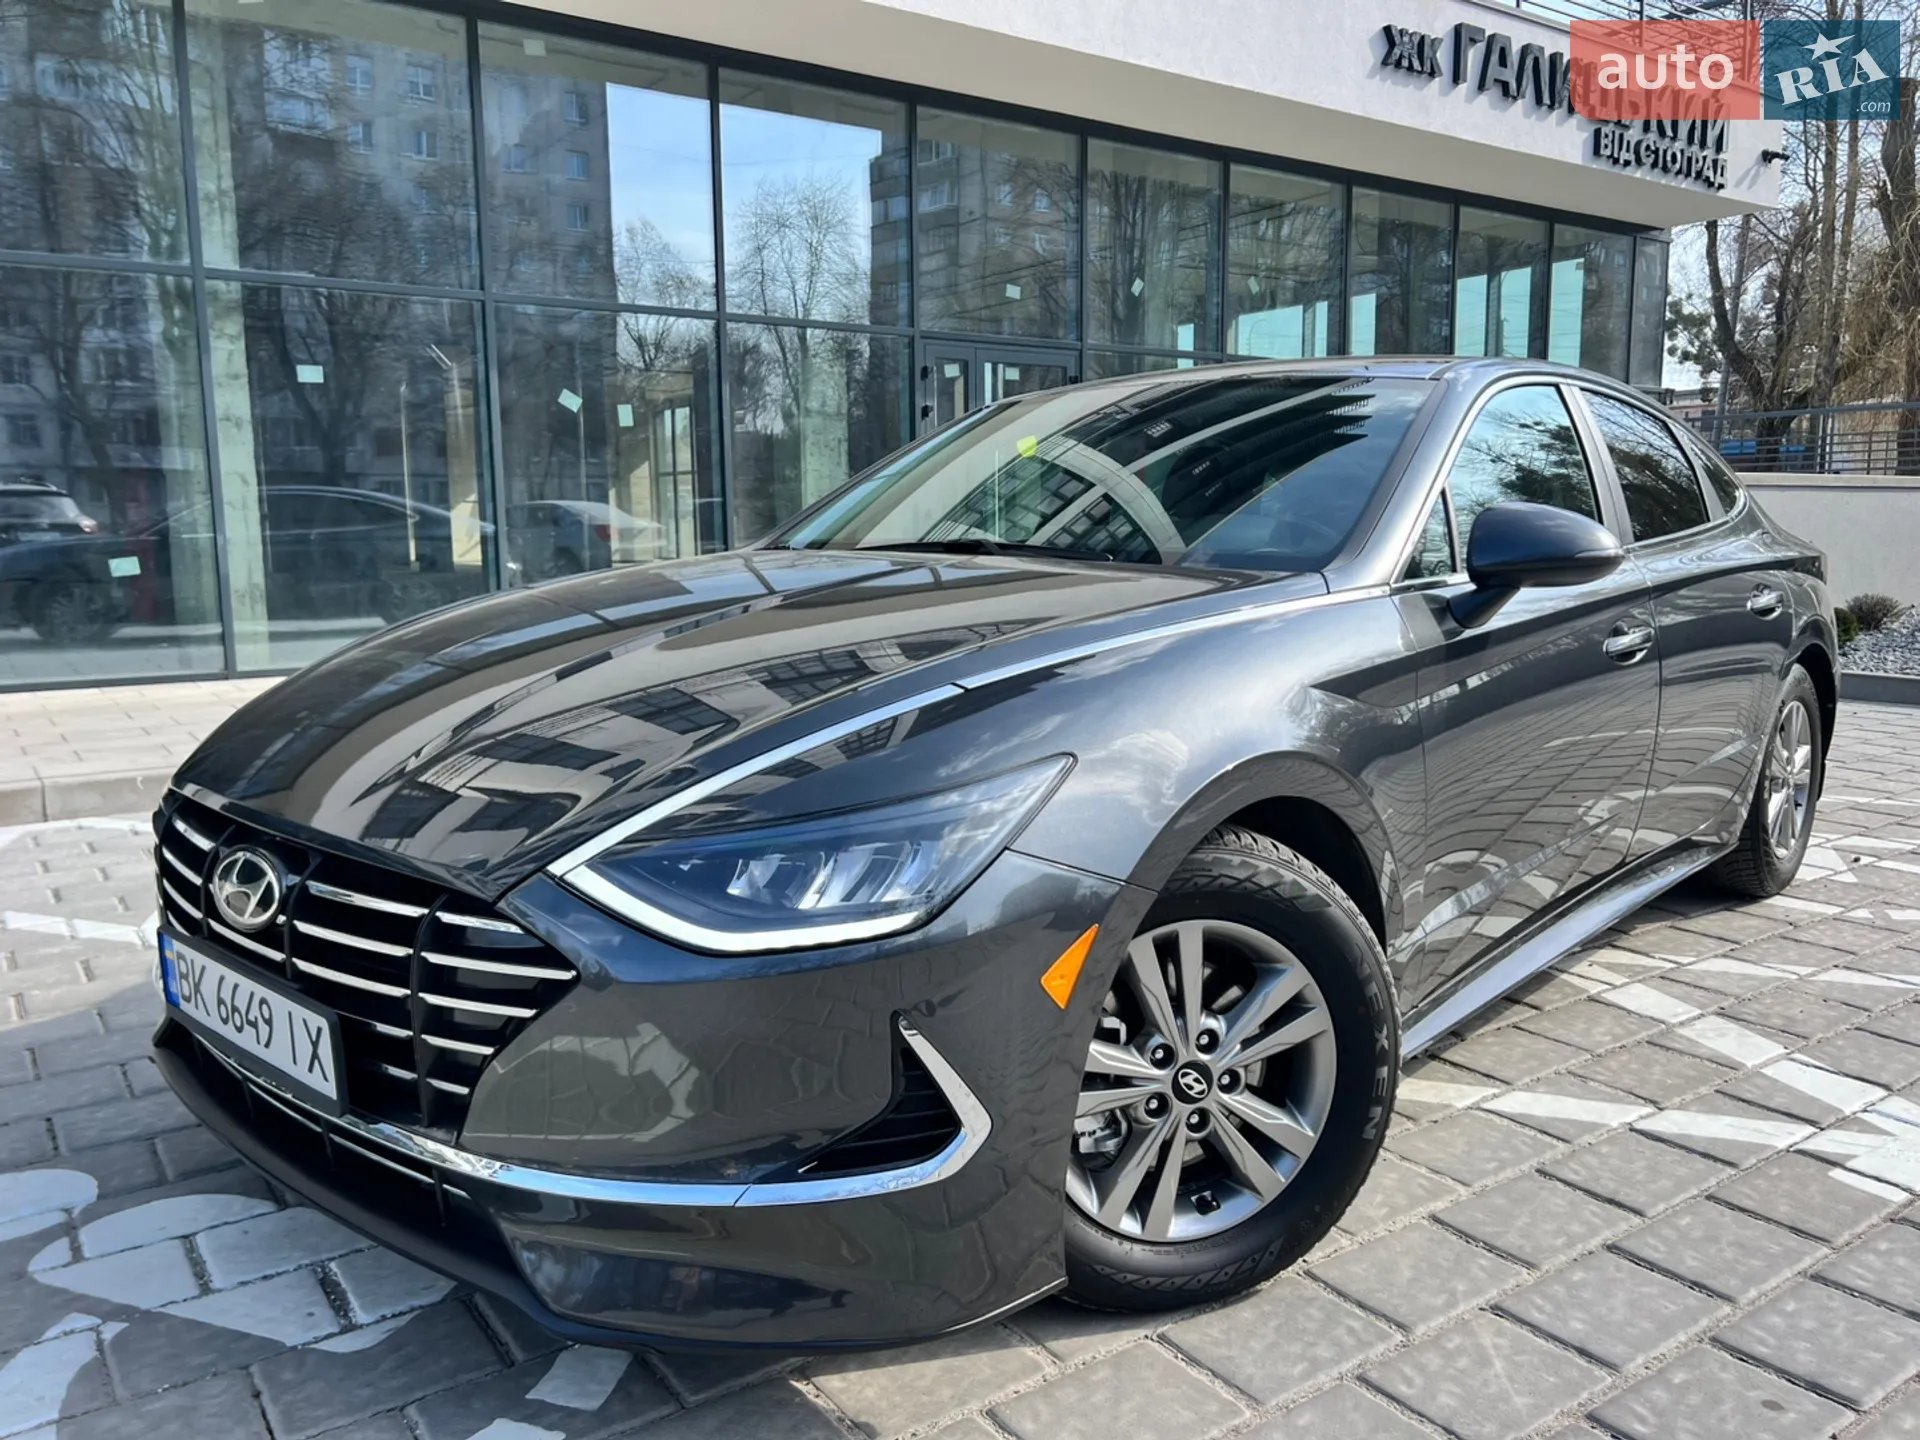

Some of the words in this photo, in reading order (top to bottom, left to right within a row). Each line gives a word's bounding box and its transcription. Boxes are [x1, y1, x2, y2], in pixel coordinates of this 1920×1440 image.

[1381, 24, 1444, 78] ЖК
[1593, 127, 1635, 168] ВІД
[175, 949, 211, 1018] BK
[216, 974, 274, 1050] 6649
[287, 1010, 330, 1083] IX
[1355, 942, 1389, 1140] NEXEN
